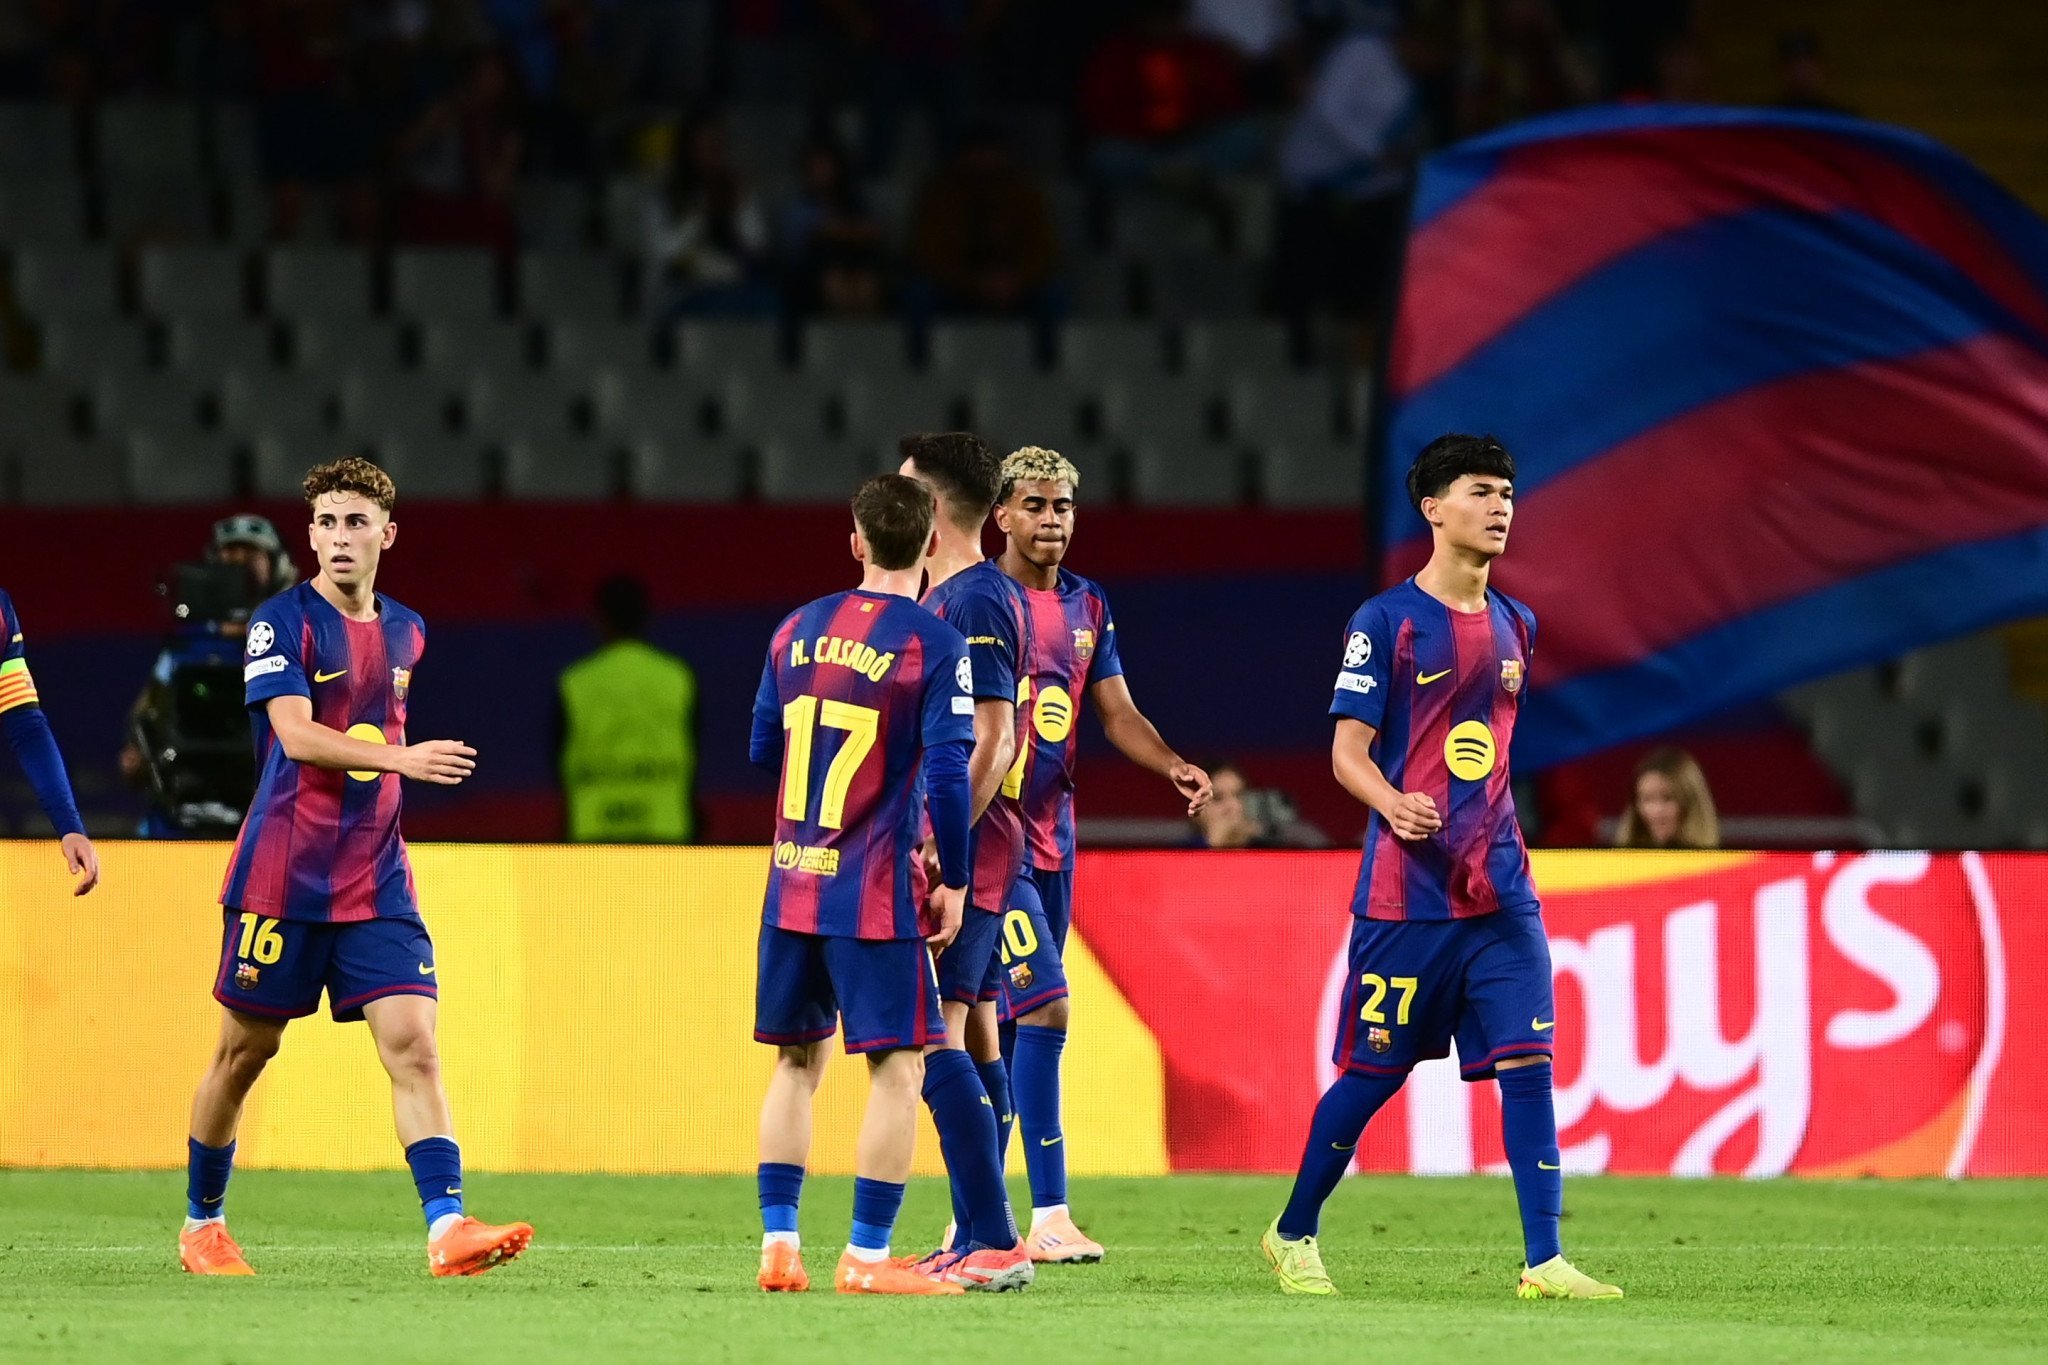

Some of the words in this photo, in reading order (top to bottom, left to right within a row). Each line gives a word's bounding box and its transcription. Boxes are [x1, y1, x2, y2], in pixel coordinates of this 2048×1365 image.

[814, 636, 895, 683] CASADÓ
[783, 694, 880, 830] 17
[238, 913, 284, 965] 16
[1360, 973, 1418, 1026] 27
